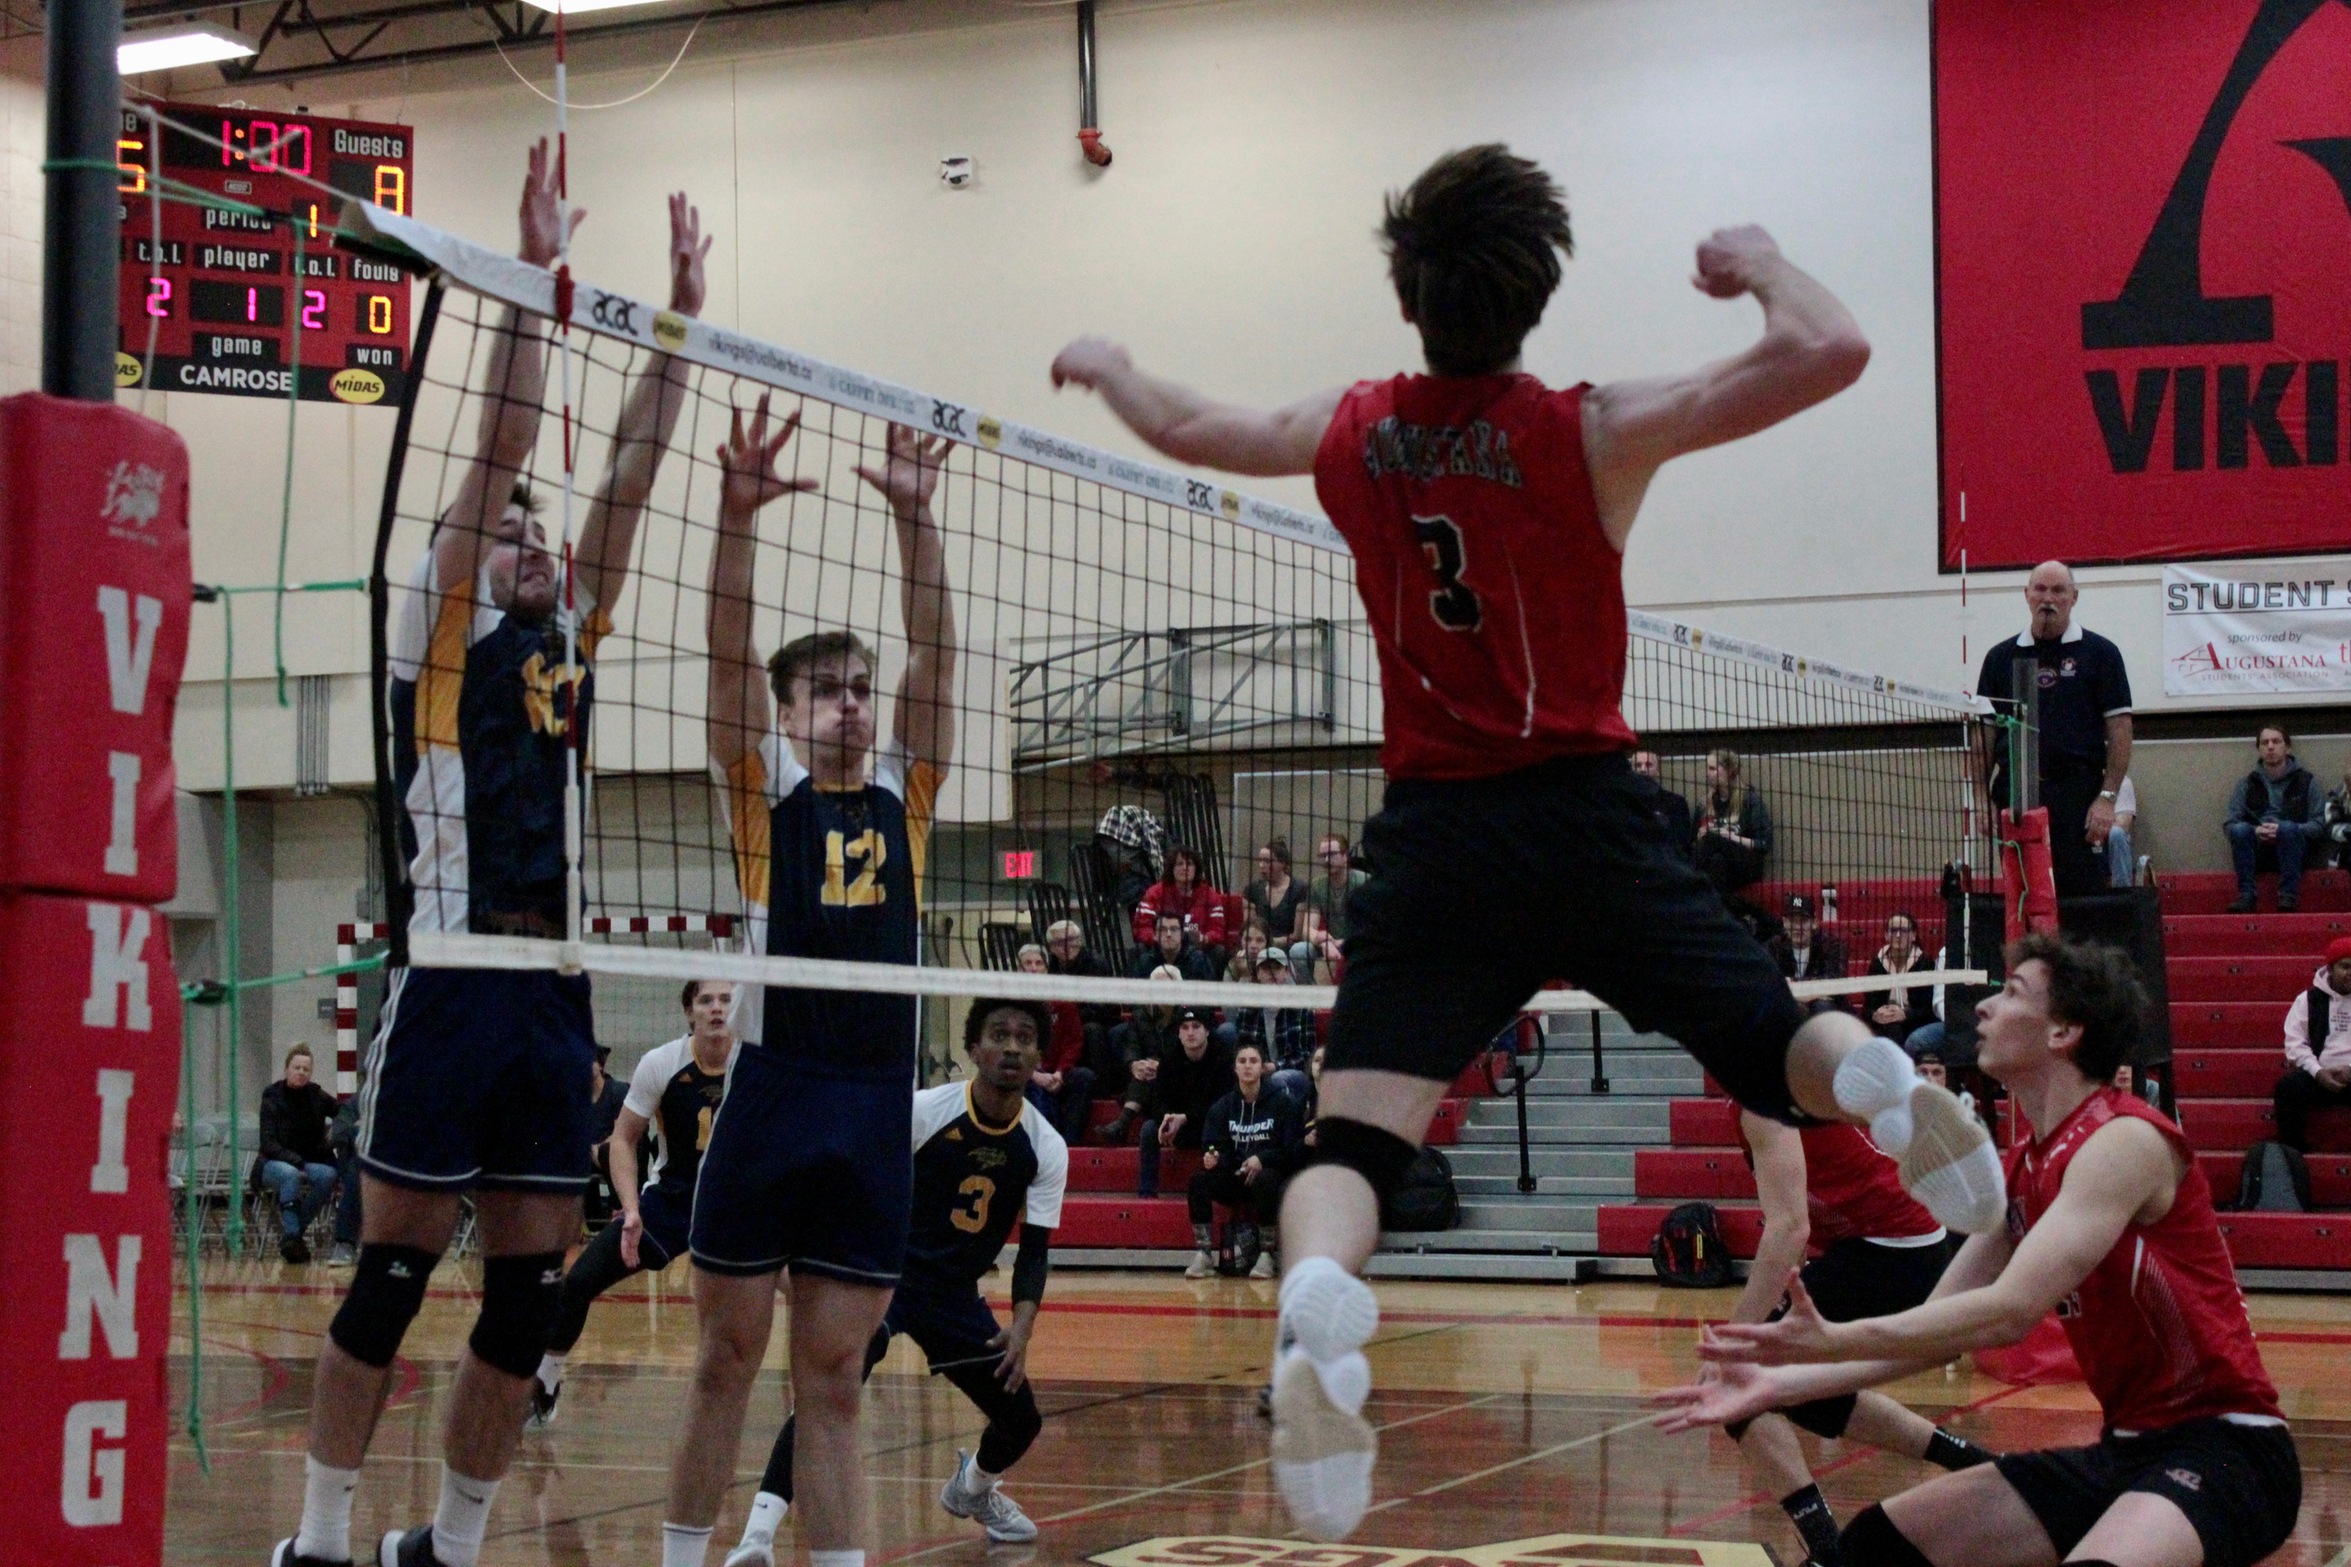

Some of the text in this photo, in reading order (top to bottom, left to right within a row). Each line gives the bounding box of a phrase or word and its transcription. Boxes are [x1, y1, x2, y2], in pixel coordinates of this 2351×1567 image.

[222, 120, 313, 177] 1:00
[334, 129, 404, 159] Guests
[309, 203, 318, 238] 1
[204, 246, 270, 271] player
[146, 277, 172, 317] 2
[247, 287, 257, 322] 1
[301, 289, 326, 329] 2
[368, 295, 392, 334] 0
[211, 336, 262, 357] game
[356, 348, 393, 366] won
[179, 364, 294, 393] CAMROSE
[334, 375, 381, 394] MIDAS
[2083, 359, 2351, 476] VIKI
[1411, 514, 1482, 633] 3
[2167, 579, 2336, 612] STUDENT
[2227, 630, 2303, 645] sponsored by
[2172, 641, 2328, 671] AUGUSTANA
[2259, 668, 2330, 681] ASSOCIATION
[820, 828, 887, 908] 12
[1228, 1117, 1274, 1134] THUNDER
[950, 1175, 997, 1234] 3
